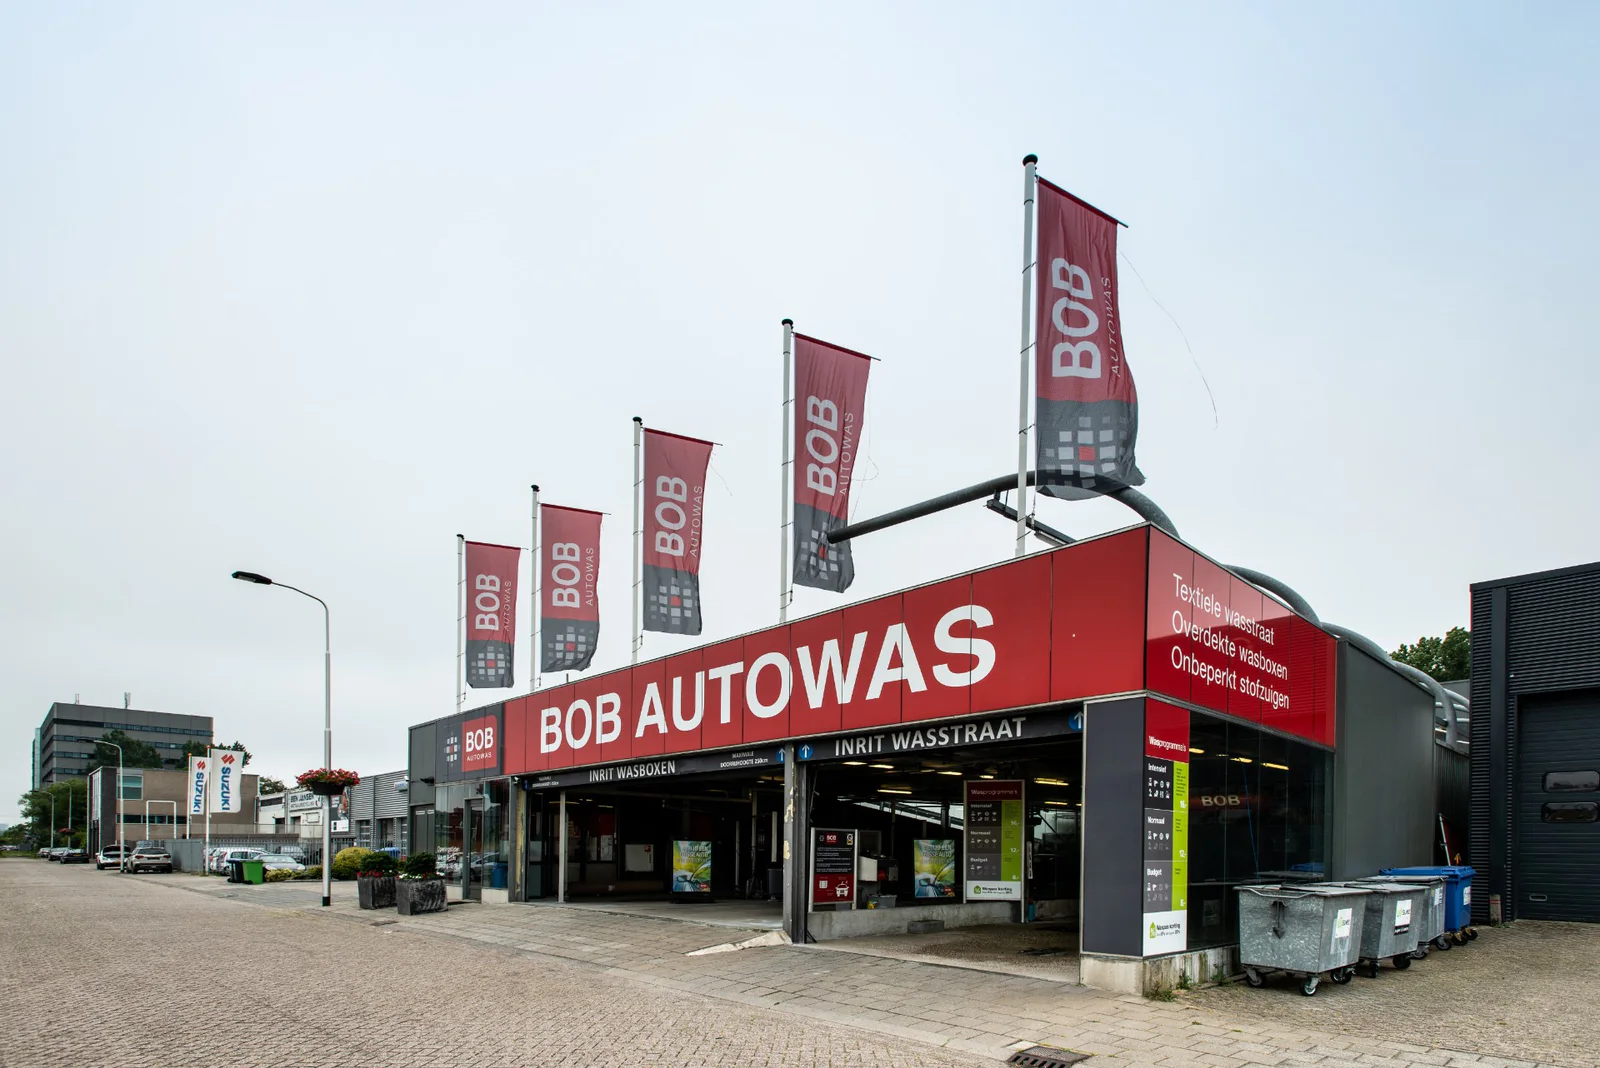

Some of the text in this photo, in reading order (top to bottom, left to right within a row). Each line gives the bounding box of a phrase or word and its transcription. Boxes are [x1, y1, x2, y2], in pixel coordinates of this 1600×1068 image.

[1052, 258, 1101, 378] BOB
[1101, 277, 1120, 377] AUTOWAS
[806, 395, 838, 496] BOB
[840, 412, 854, 495] AUTOWAS
[655, 475, 687, 556] BOB
[689, 485, 702, 557] AUTOWAS
[475, 574, 500, 630] BOB
[551, 542, 580, 608] BOB
[585, 547, 594, 606] AUTOWAS
[503, 580, 512, 631] AUTOWAS
[1173, 573, 1274, 645] Textiele wasstraat
[1172, 610, 1288, 680] Overdekte wasboxen
[540, 605, 996, 754] BOB AUTOWAS
[1171, 645, 1289, 710] Onbeperkt stofzuigen
[466, 727, 494, 752] BOB
[466, 752, 492, 762] AUTOWAS
[835, 717, 1026, 756] INRIT WASSTRAAT
[1149, 735, 1187, 752] Wasprogramma's
[193, 772, 204, 813] SUZUKI
[221, 766, 231, 811] SUZUKI
[589, 760, 676, 782] INRIT WASBOXEN
[1148, 763, 1167, 773] Intensief
[1147, 816, 1165, 825] Normaal
[1201, 795, 1240, 806] BOB
[1147, 868, 1163, 877] Budget
